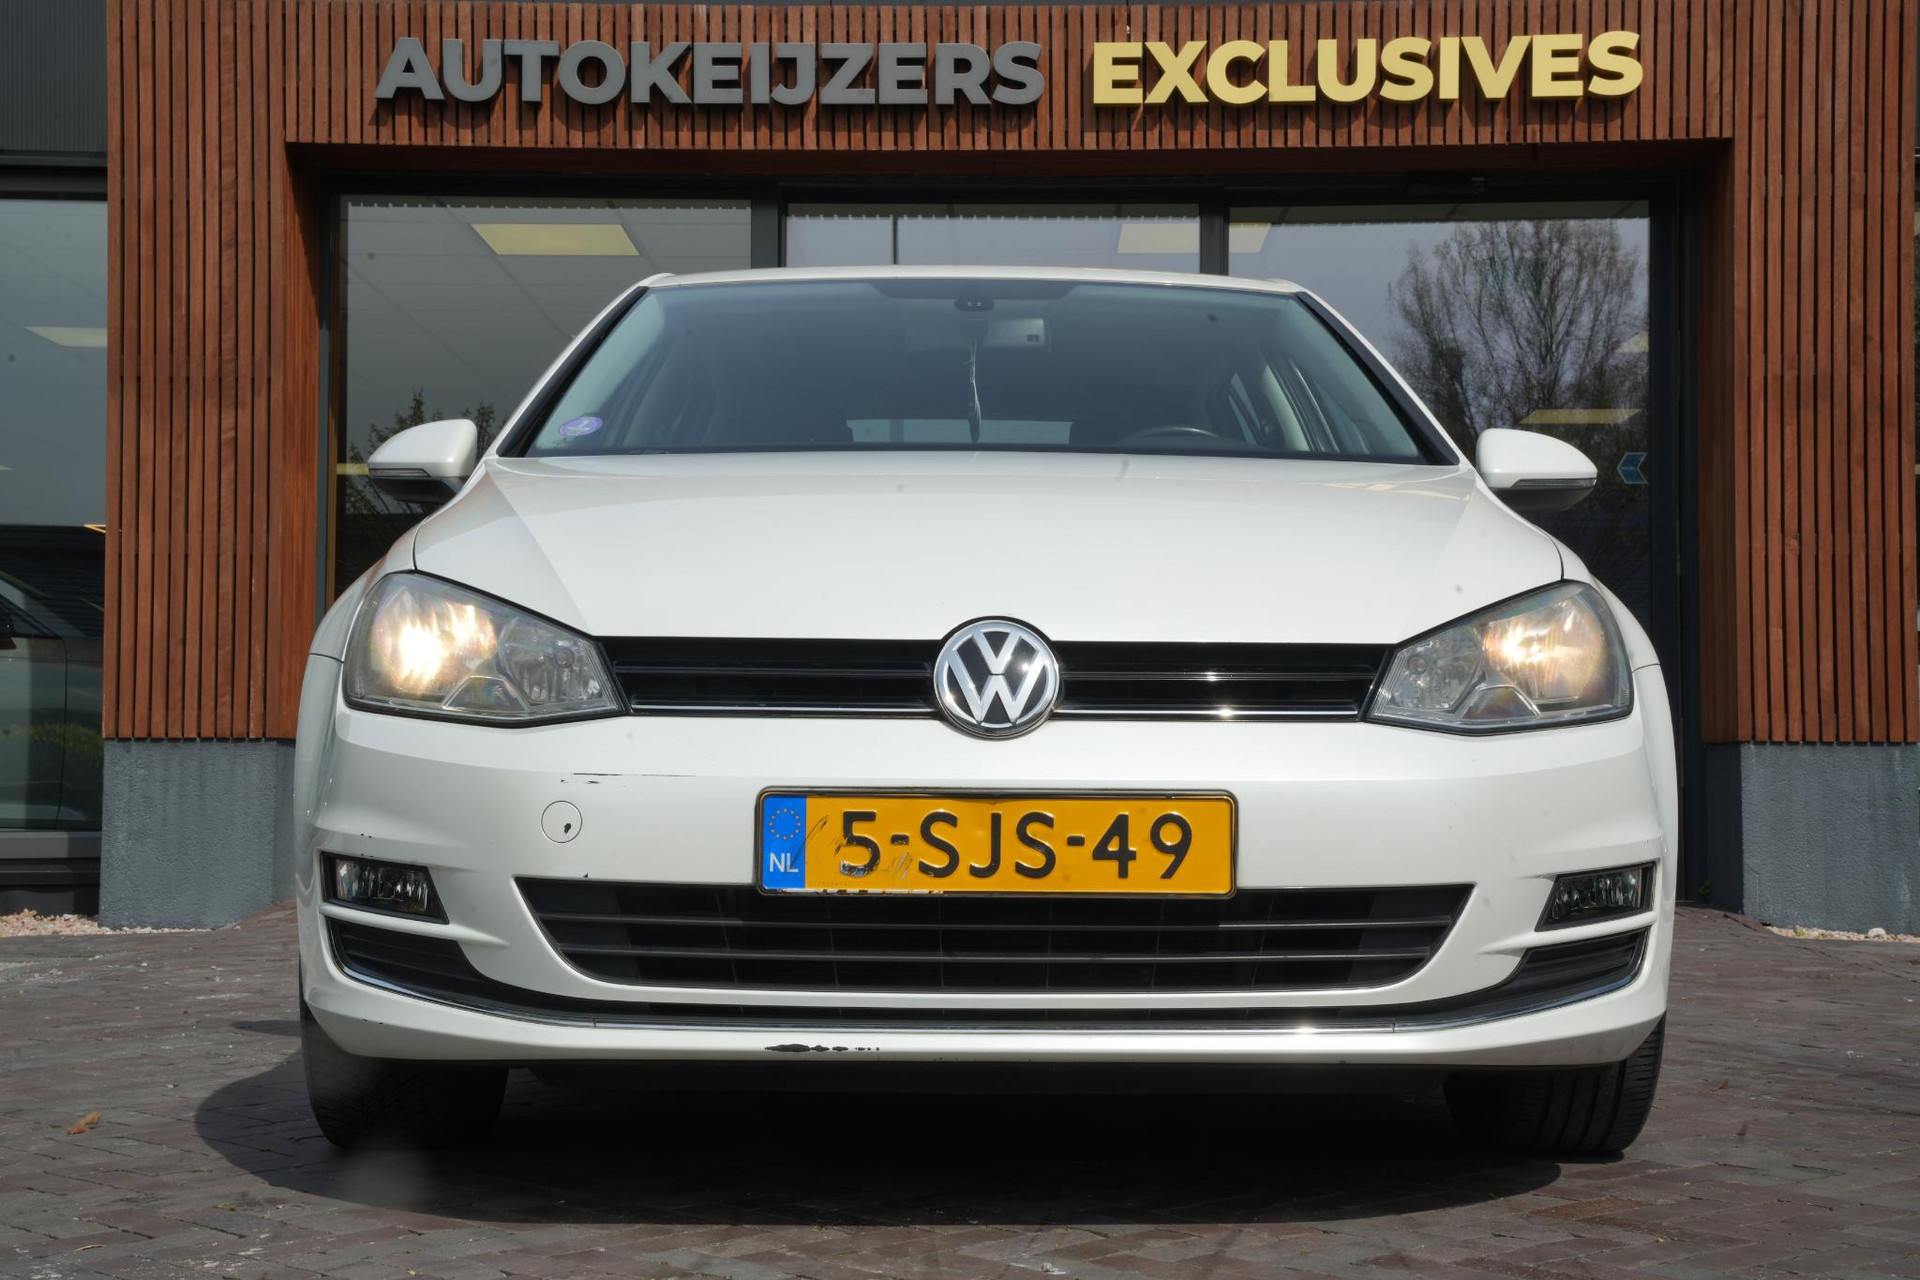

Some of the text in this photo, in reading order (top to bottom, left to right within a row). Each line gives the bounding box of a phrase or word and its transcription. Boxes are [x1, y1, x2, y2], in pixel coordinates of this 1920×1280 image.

[375, 30, 1644, 107] AUTOKEIJZERS EXCLUSIVES
[769, 852, 799, 873] NL
[839, 810, 1193, 880] 5-SJS-49
